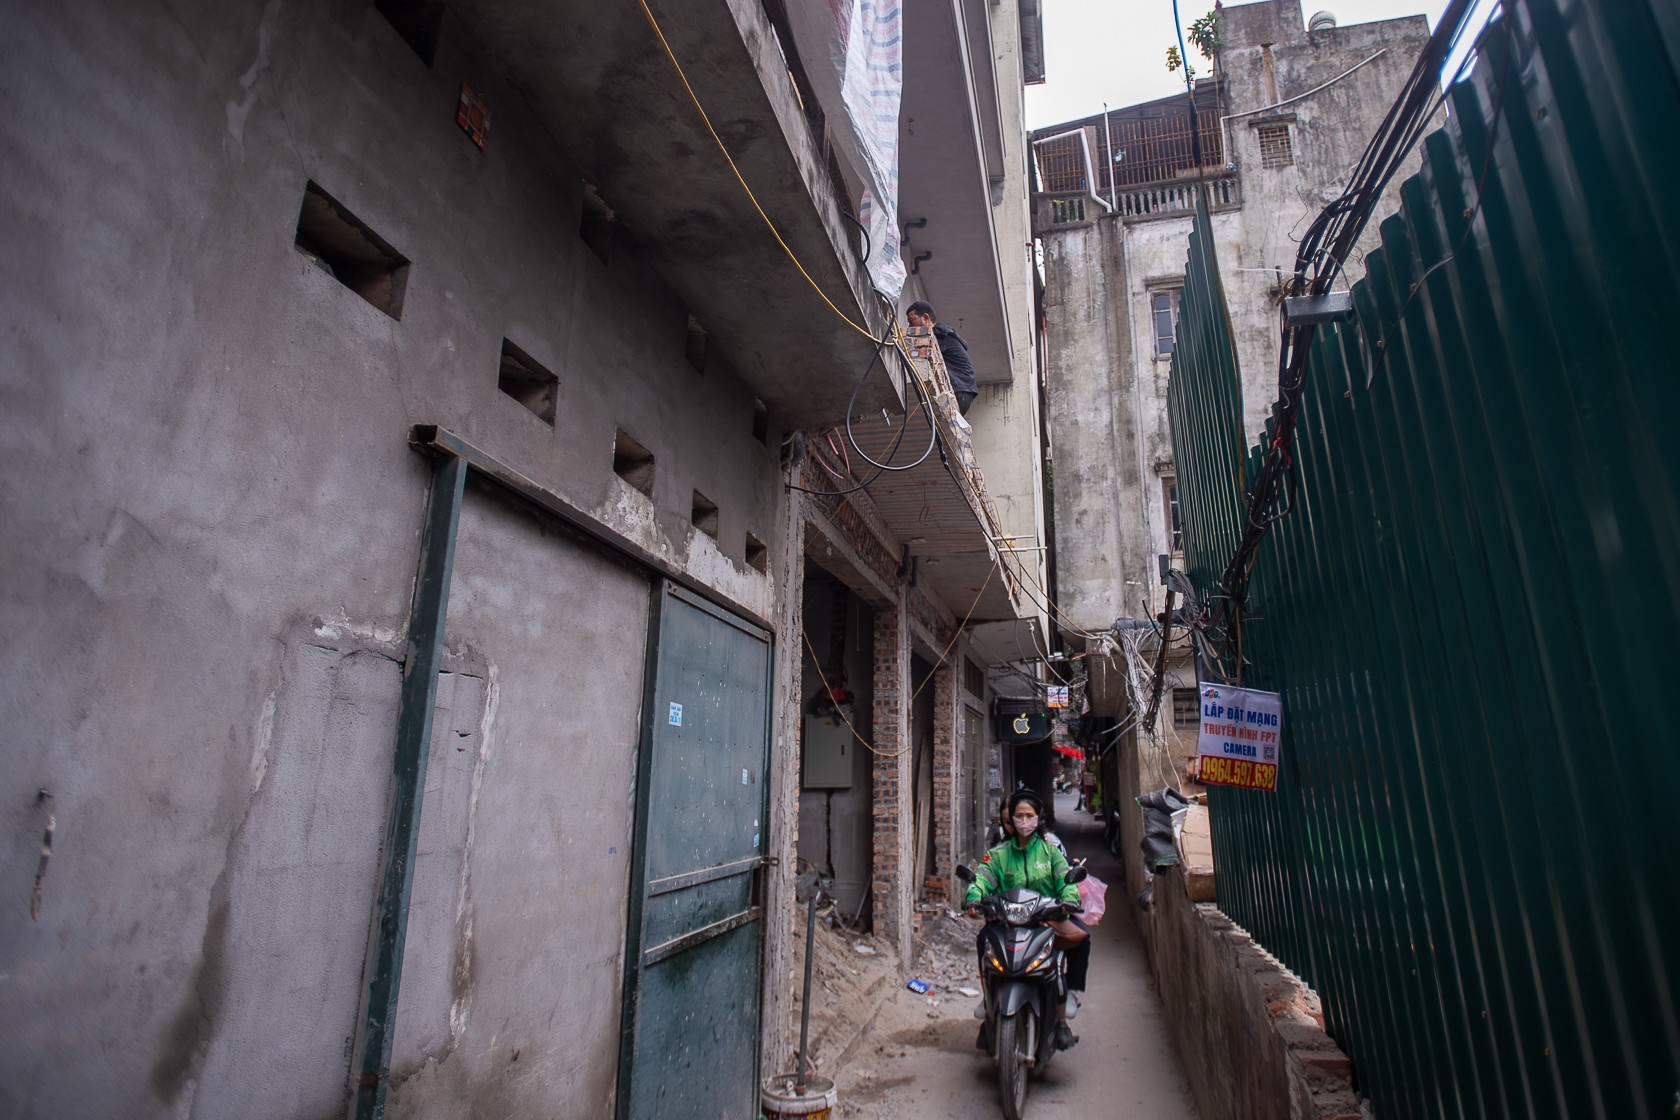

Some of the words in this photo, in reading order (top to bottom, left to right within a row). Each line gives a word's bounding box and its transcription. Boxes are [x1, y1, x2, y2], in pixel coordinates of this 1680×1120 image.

[1227, 706, 1245, 723] ĐẶT
[1247, 710, 1277, 726] MẠNG
[1261, 731, 1277, 743] FPT
[1224, 742, 1257, 757] CAMERA
[1202, 757, 1275, 788] 0964.597.638
